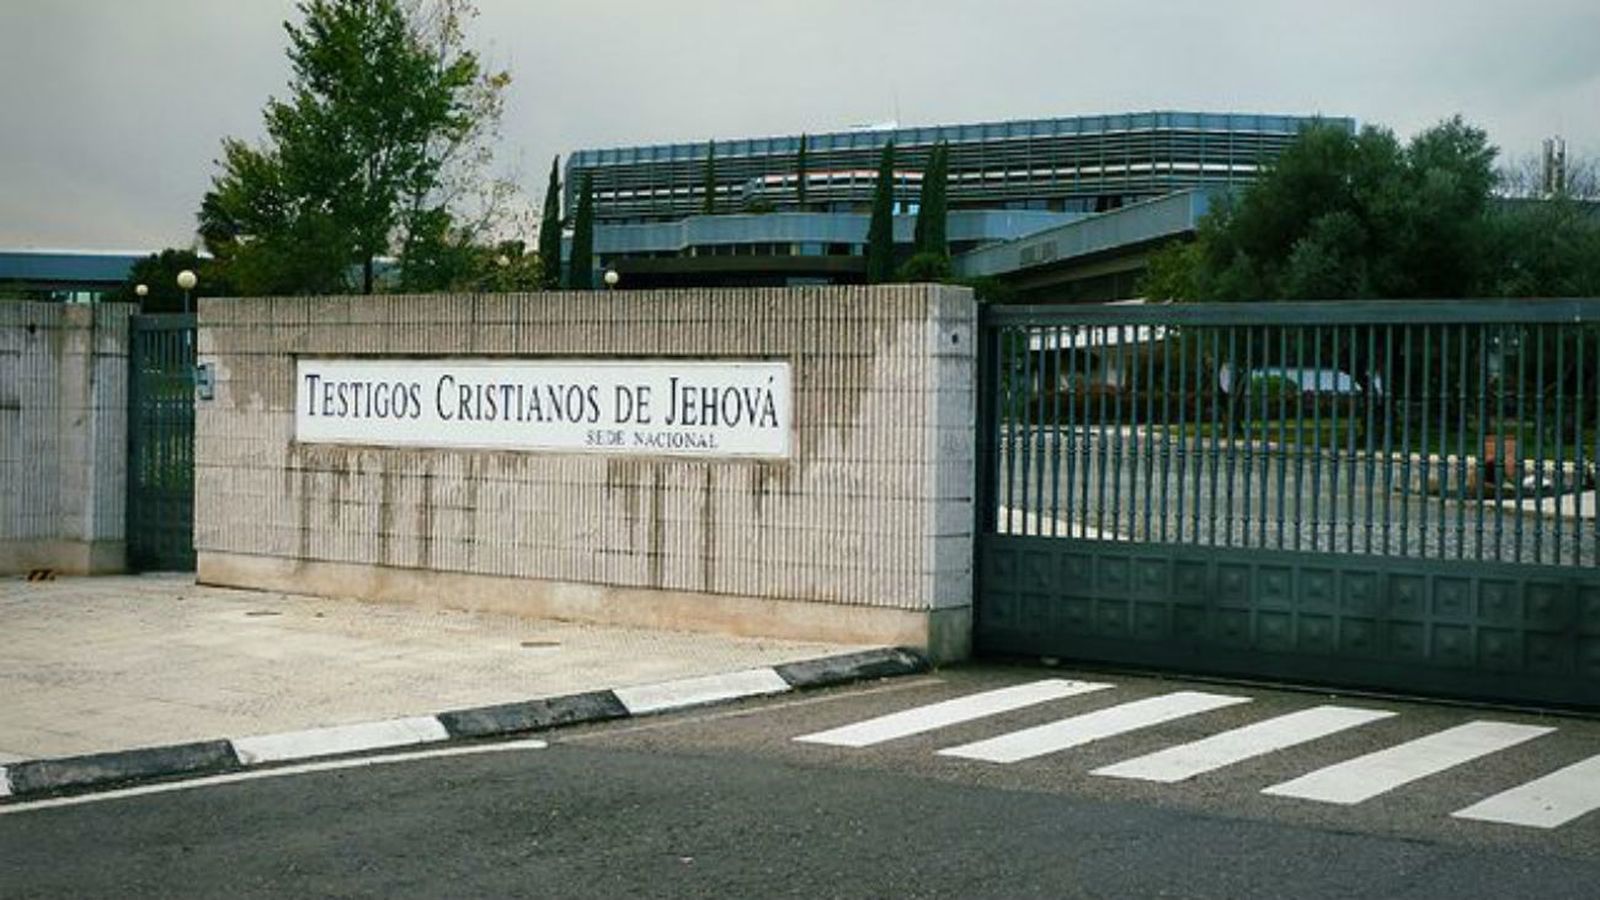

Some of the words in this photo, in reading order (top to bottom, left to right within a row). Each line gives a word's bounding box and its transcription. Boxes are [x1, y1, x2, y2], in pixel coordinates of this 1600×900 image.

[305, 374, 422, 419] TESTIGOS
[437, 374, 600, 424] CRISTIANOS
[614, 384, 651, 424] DE
[665, 376, 778, 428] JEHOVÁ
[585, 430, 625, 446] SEDE
[634, 431, 719, 449] NACIONAL
